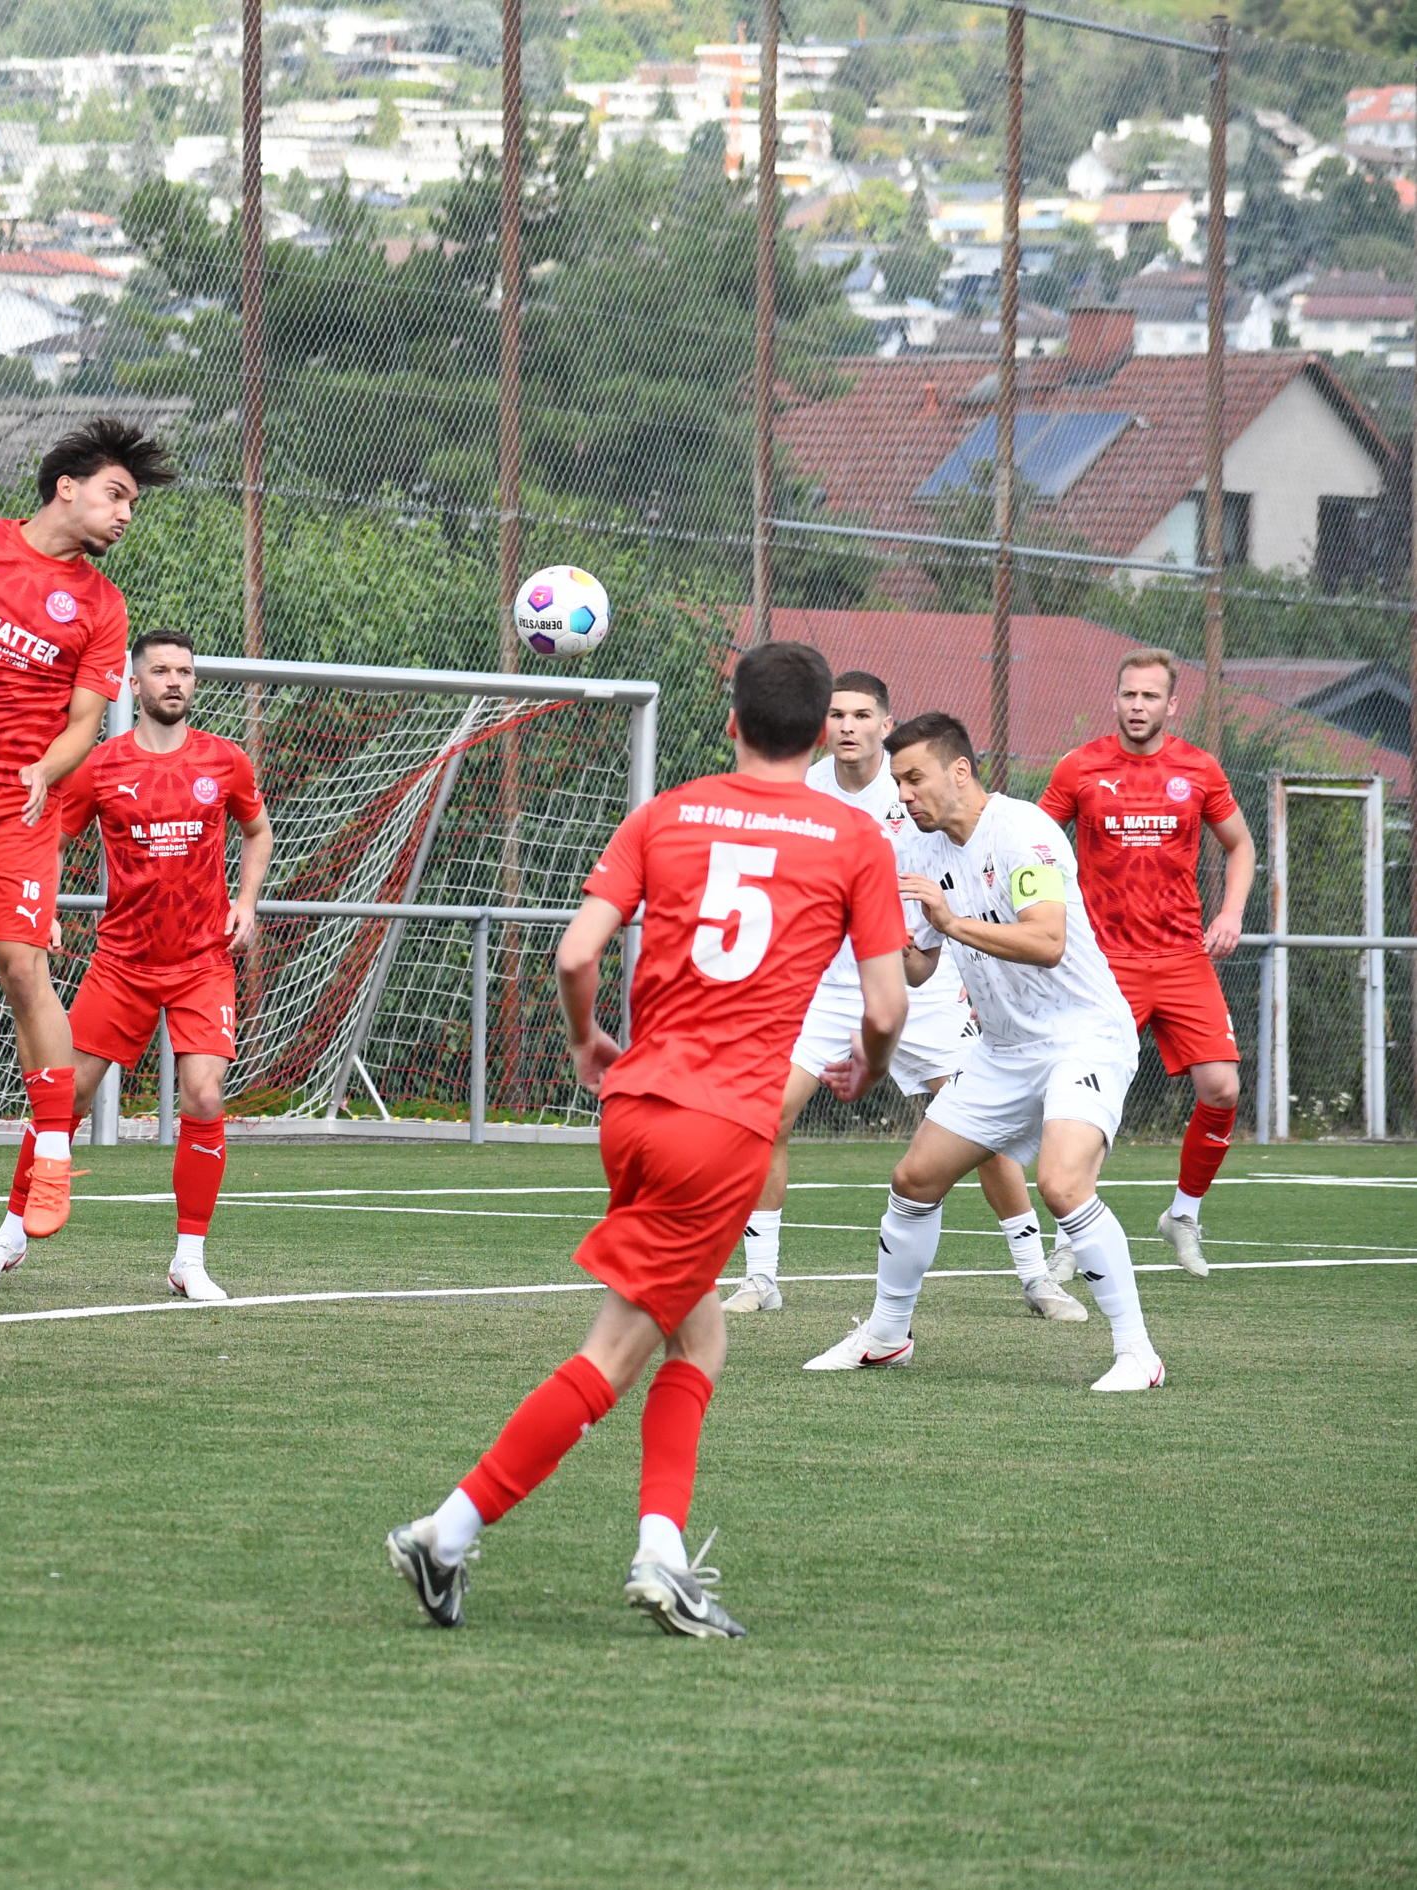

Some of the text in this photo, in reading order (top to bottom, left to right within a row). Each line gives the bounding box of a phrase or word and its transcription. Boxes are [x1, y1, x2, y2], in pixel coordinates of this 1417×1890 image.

[678, 804, 706, 823] TSG
[1105, 815, 1178, 829] M. MATTER
[131, 821, 203, 839] M. MATTER
[22, 879, 40, 901] 16
[1019, 870, 1037, 897] C
[691, 841, 778, 982] 5
